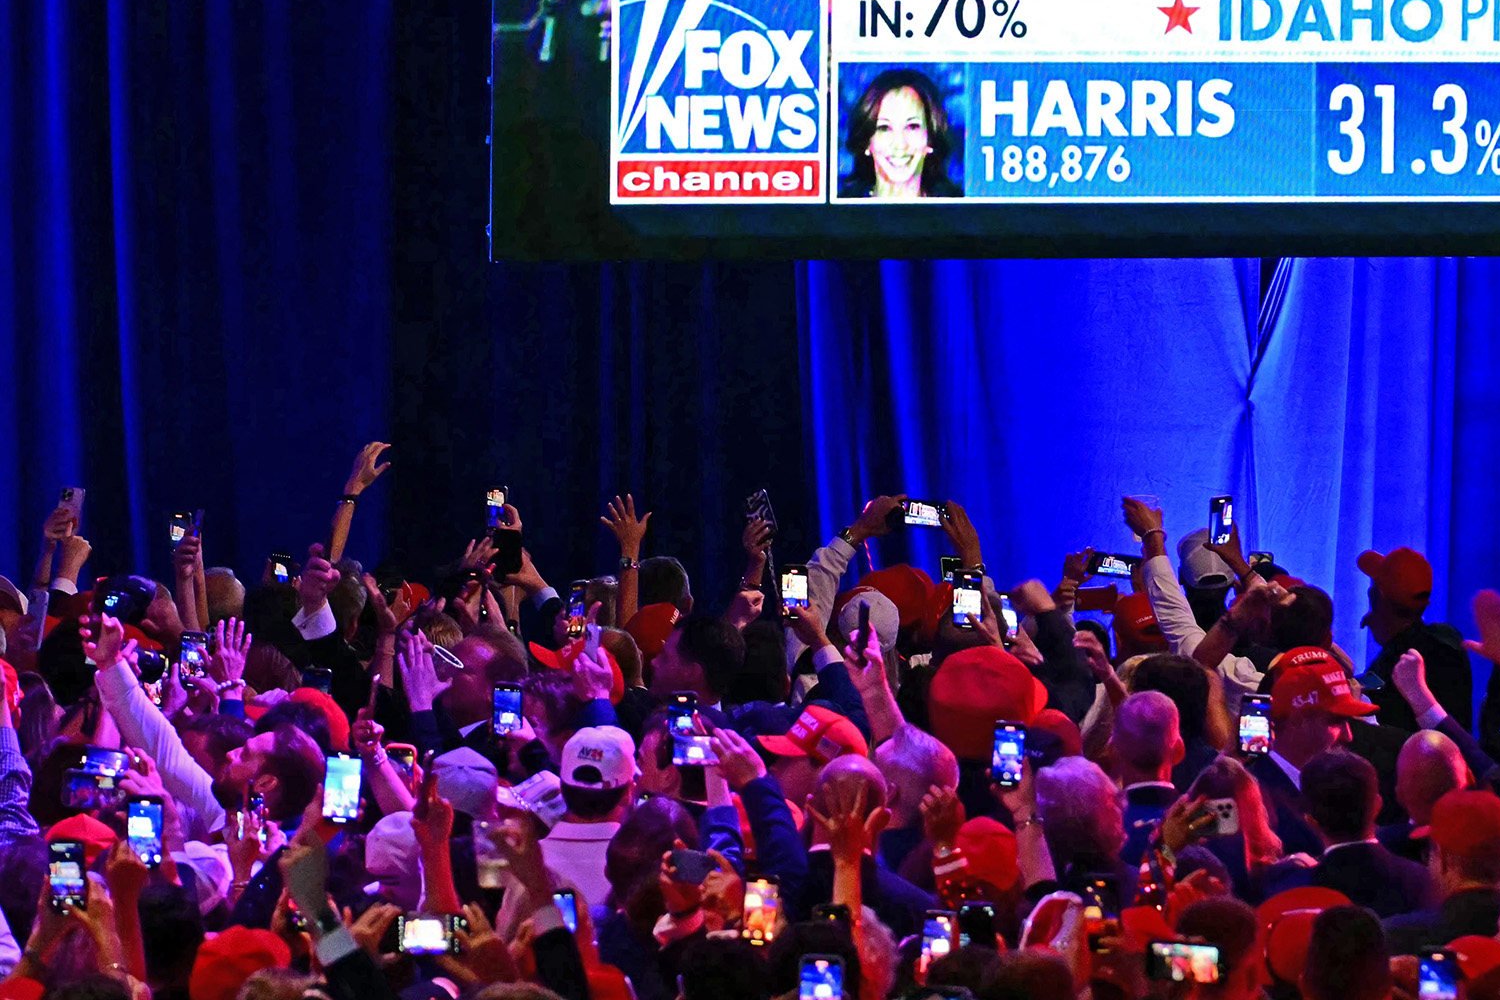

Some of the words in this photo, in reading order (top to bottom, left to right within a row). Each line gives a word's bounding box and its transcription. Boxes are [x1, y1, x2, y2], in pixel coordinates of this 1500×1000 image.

[684, 29, 815, 89] FOX
[645, 94, 817, 151] NEWS
[979, 78, 1236, 138] HARRIS
[622, 164, 814, 192] channel
[981, 144, 1132, 188] 188,876
[1290, 650, 1329, 665] TRUMP
